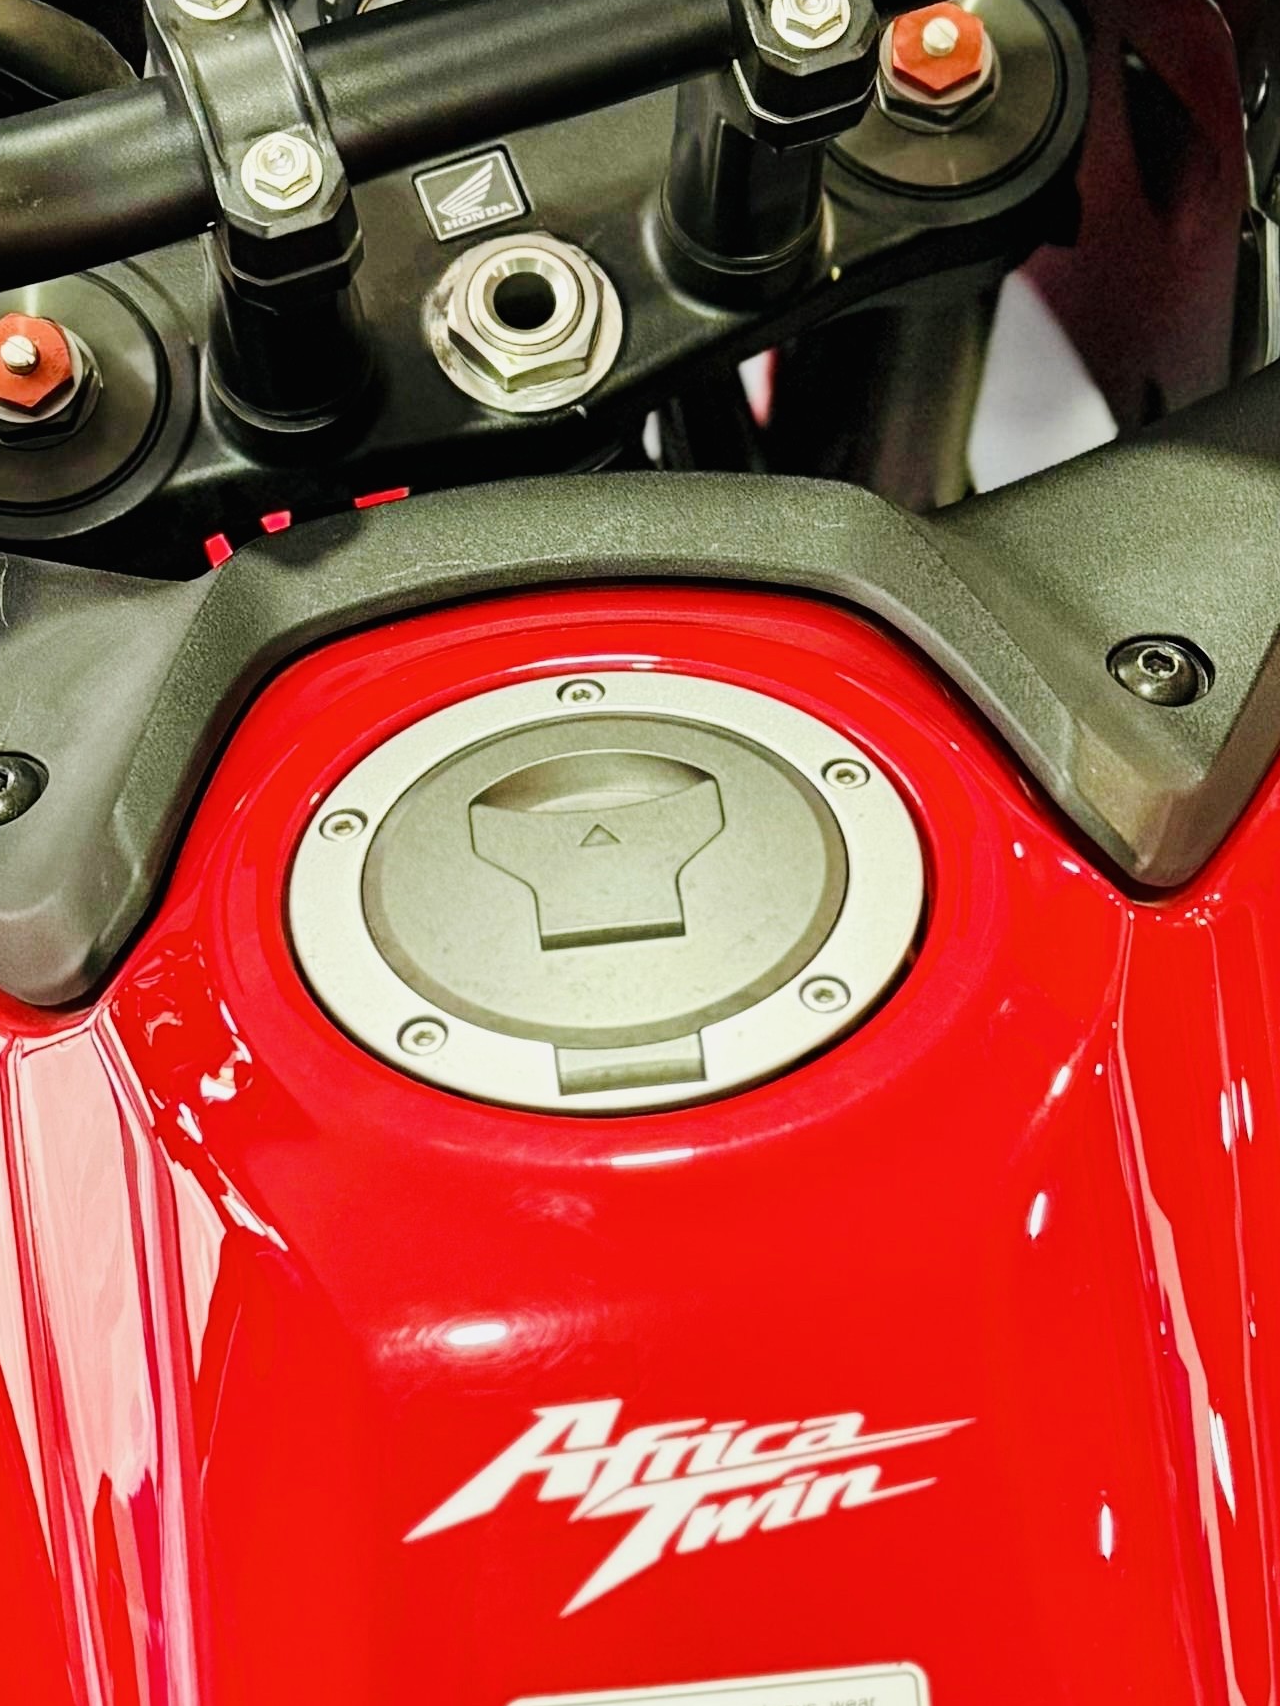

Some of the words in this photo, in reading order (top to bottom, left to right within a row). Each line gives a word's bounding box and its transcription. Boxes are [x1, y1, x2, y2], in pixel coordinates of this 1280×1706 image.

[442, 202, 515, 231] HONDA
[402, 1397, 977, 1544] Africa
[559, 1430, 952, 1618] Twin
